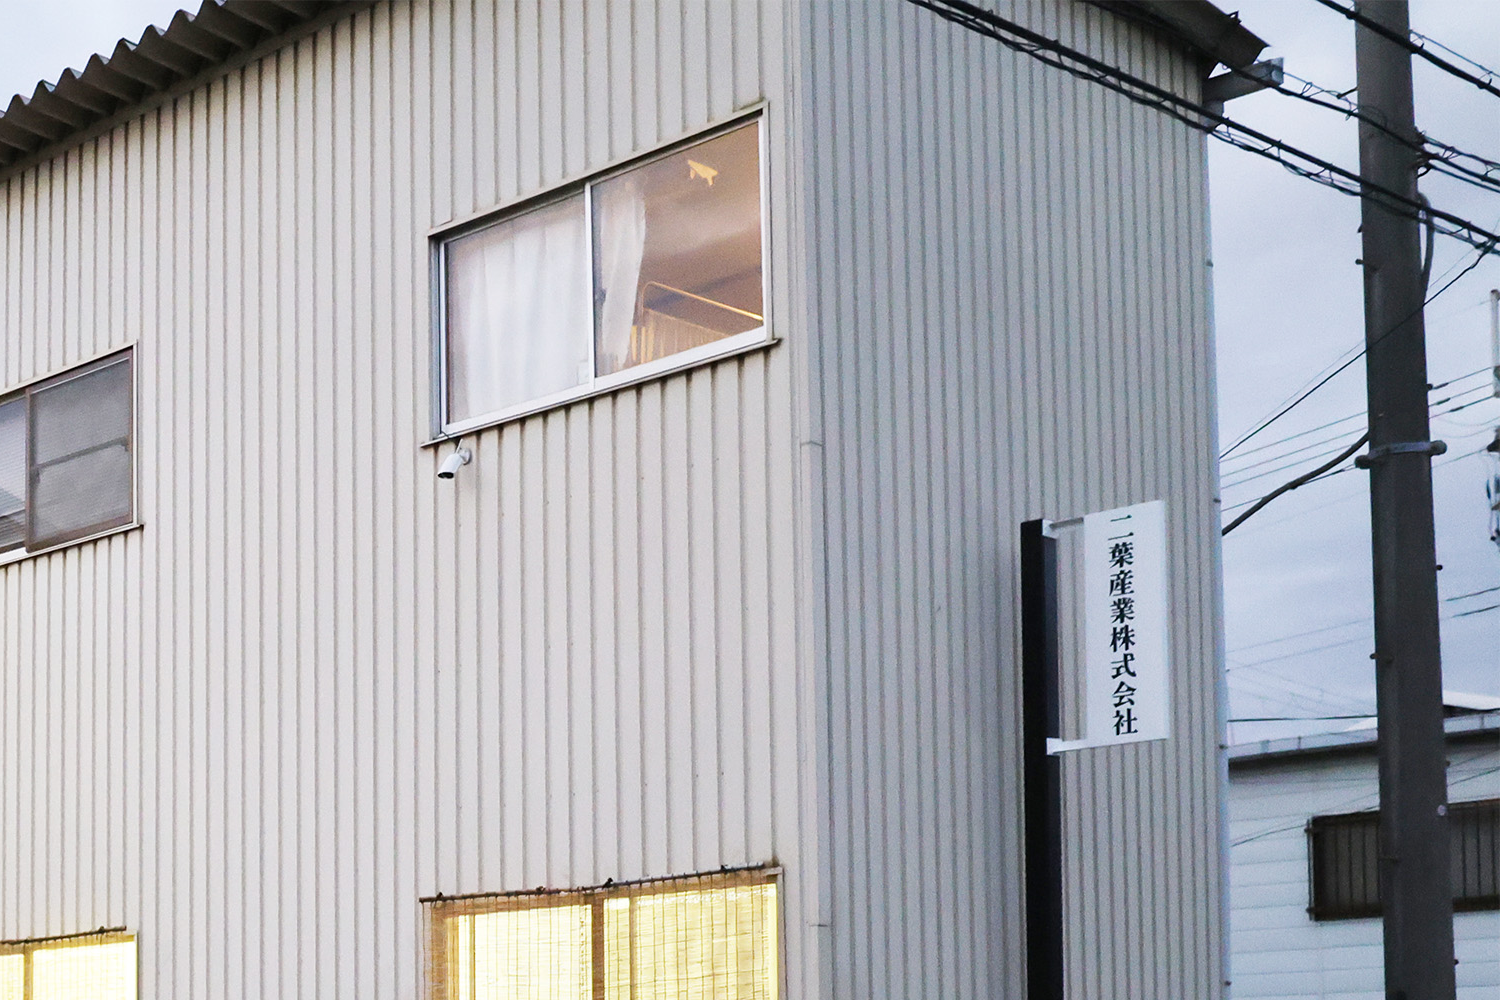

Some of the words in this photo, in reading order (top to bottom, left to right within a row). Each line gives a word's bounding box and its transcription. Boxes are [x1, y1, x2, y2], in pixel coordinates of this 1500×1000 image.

[1107, 514, 1139, 736] 二葉産業株式会社
